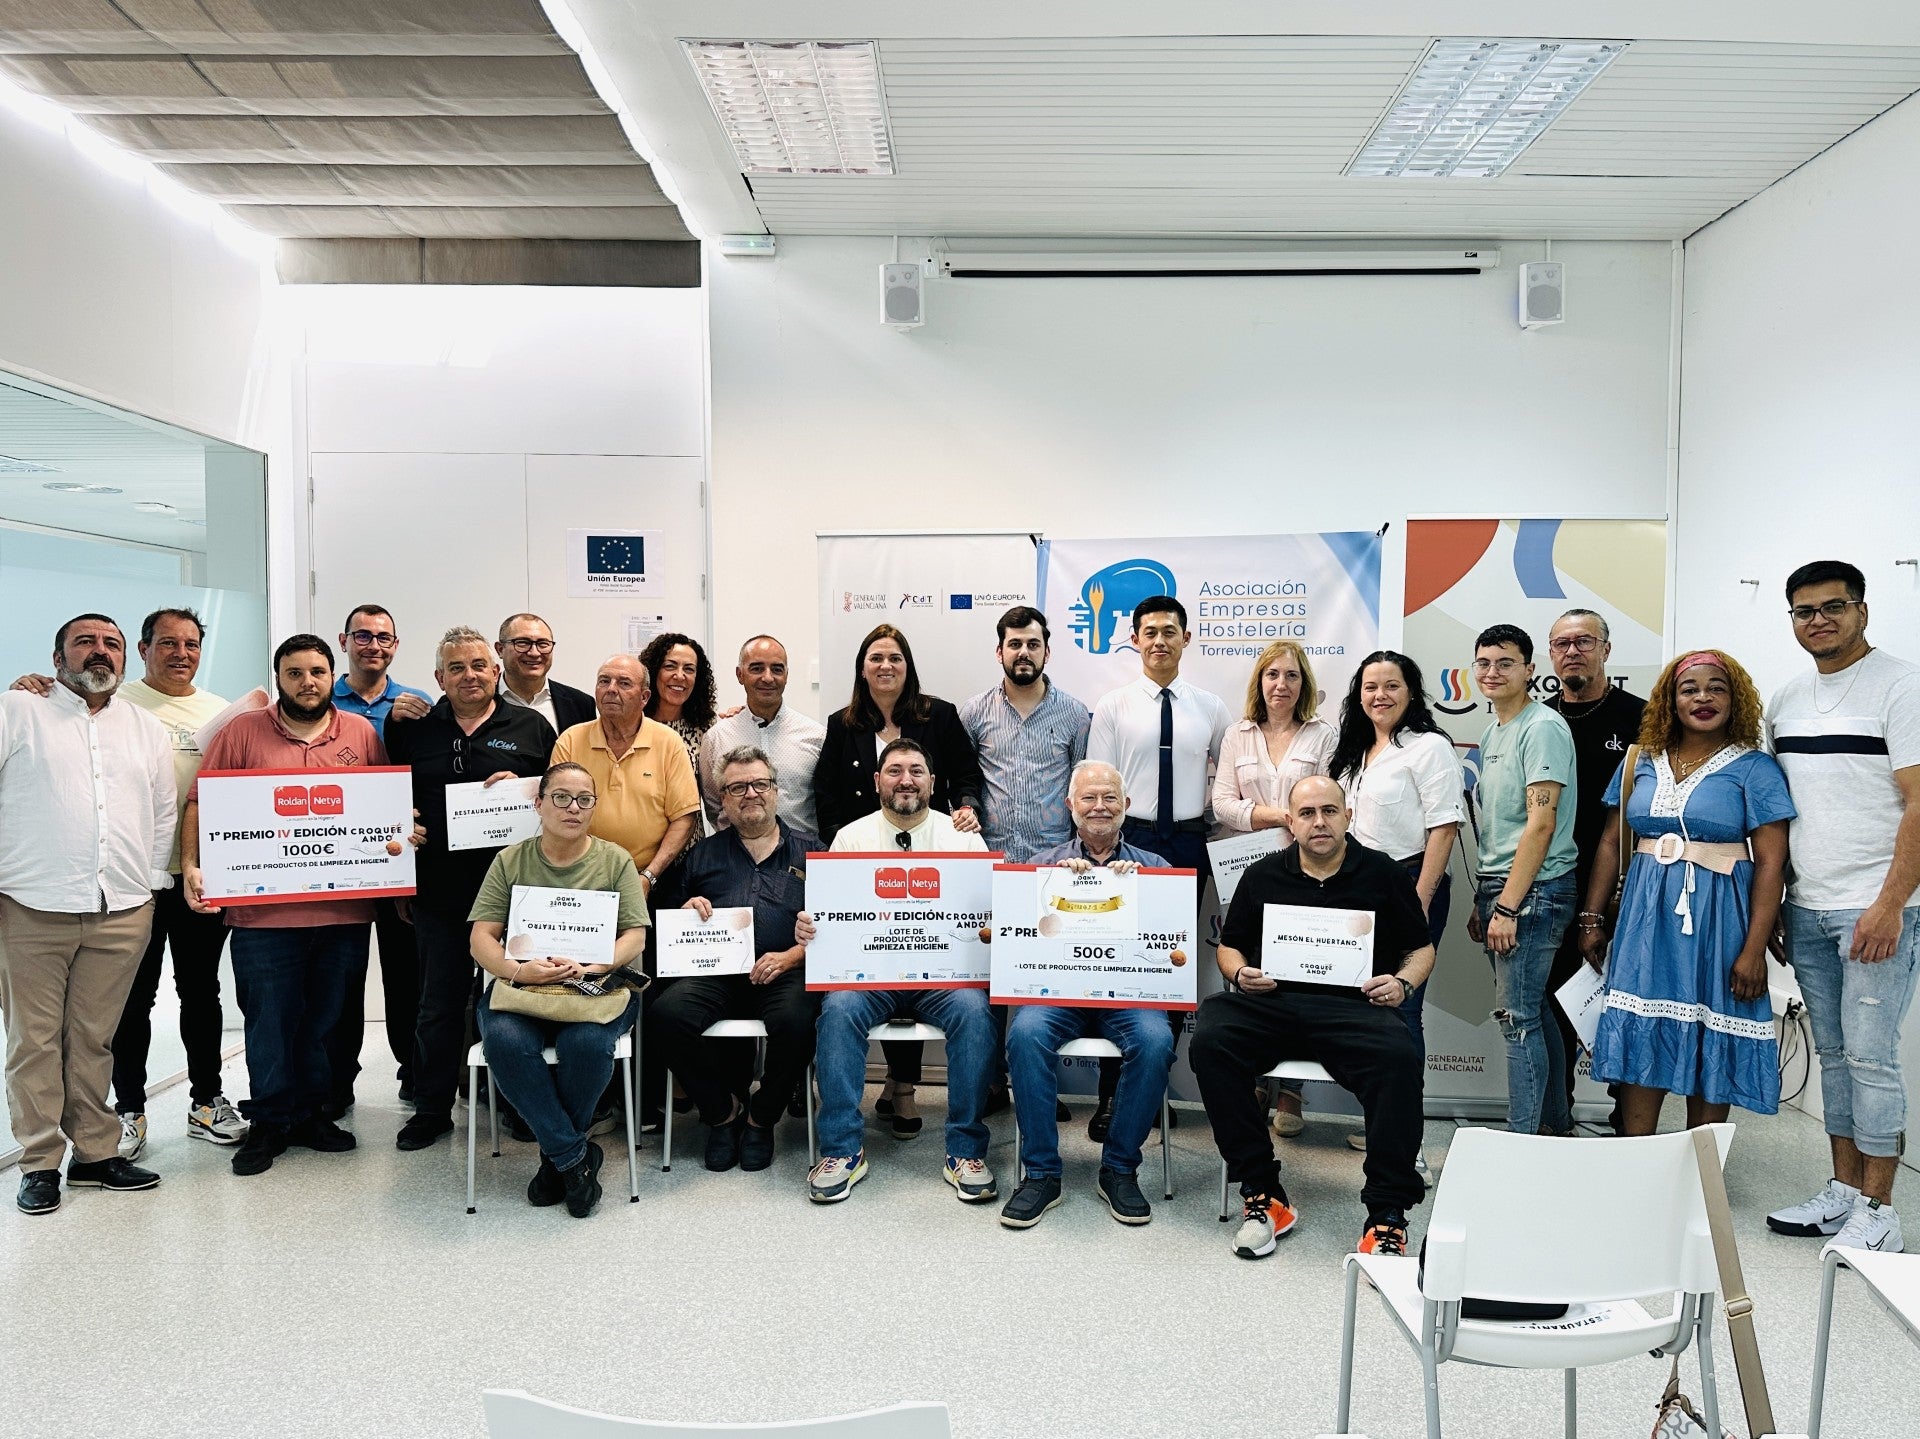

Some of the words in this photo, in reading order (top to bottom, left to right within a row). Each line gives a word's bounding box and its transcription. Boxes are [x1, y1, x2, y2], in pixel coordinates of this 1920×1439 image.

[1199, 579, 1306, 596] Asociación
[1200, 602, 1306, 619] Empresas
[1200, 621, 1306, 637] Hostelería
[1200, 644, 1265, 658] Torrevieja
[1304, 645, 1344, 655] marca
[278, 797, 307, 806] Roldan
[314, 796, 341, 806] Netya
[454, 807, 501, 816] RESTAURANTE
[209, 831, 220, 841] 1º
[223, 830, 275, 840] PREMIO
[278, 829, 290, 838] IV
[294, 825, 347, 837] EDICIÓN
[283, 844, 334, 856] 1000€
[264, 861, 307, 869] PRODUCTOS
[878, 879, 906, 887] Roldan
[912, 880, 938, 890] Netya
[814, 911, 826, 921] 3º
[828, 911, 876, 921] PREMIO
[879, 912, 891, 920] IV
[894, 909, 944, 920] EDICIÓN
[1000, 926, 1012, 936] 2º
[1015, 928, 1037, 937] PRE
[1146, 942, 1177, 950] ANDO
[1316, 937, 1357, 946] HUERTANO
[1073, 946, 1115, 959] 500€
[1427, 1054, 1486, 1064] GENERALITAT
[1427, 1063, 1484, 1073] VALENCIANA
